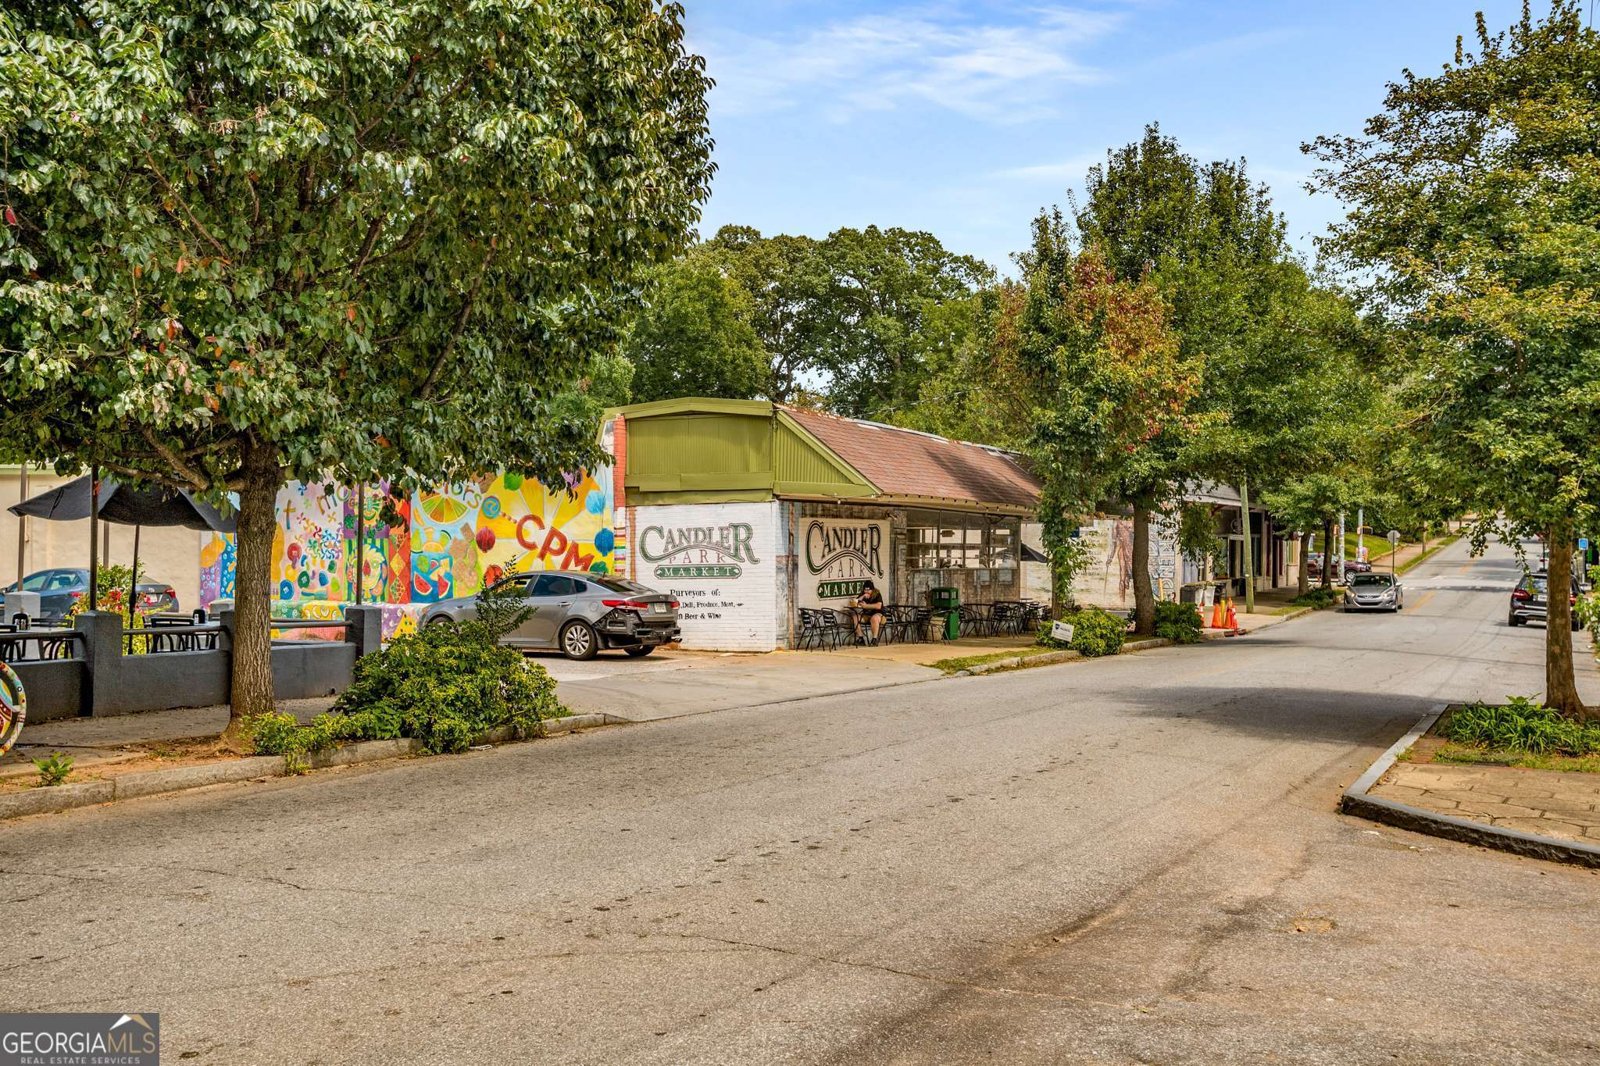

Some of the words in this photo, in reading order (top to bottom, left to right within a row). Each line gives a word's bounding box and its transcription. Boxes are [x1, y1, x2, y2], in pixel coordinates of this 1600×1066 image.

[516, 514, 594, 571] CPM
[639, 522, 760, 565] CANDLER
[806, 520, 884, 579] CANDLER
[668, 549, 726, 564] PARK
[664, 567, 732, 576] MARKET
[828, 558, 865, 578] PARK
[670, 589, 706, 598] Purveyors
[823, 582, 865, 597] MARKE
[684, 612, 698, 620] Beer
